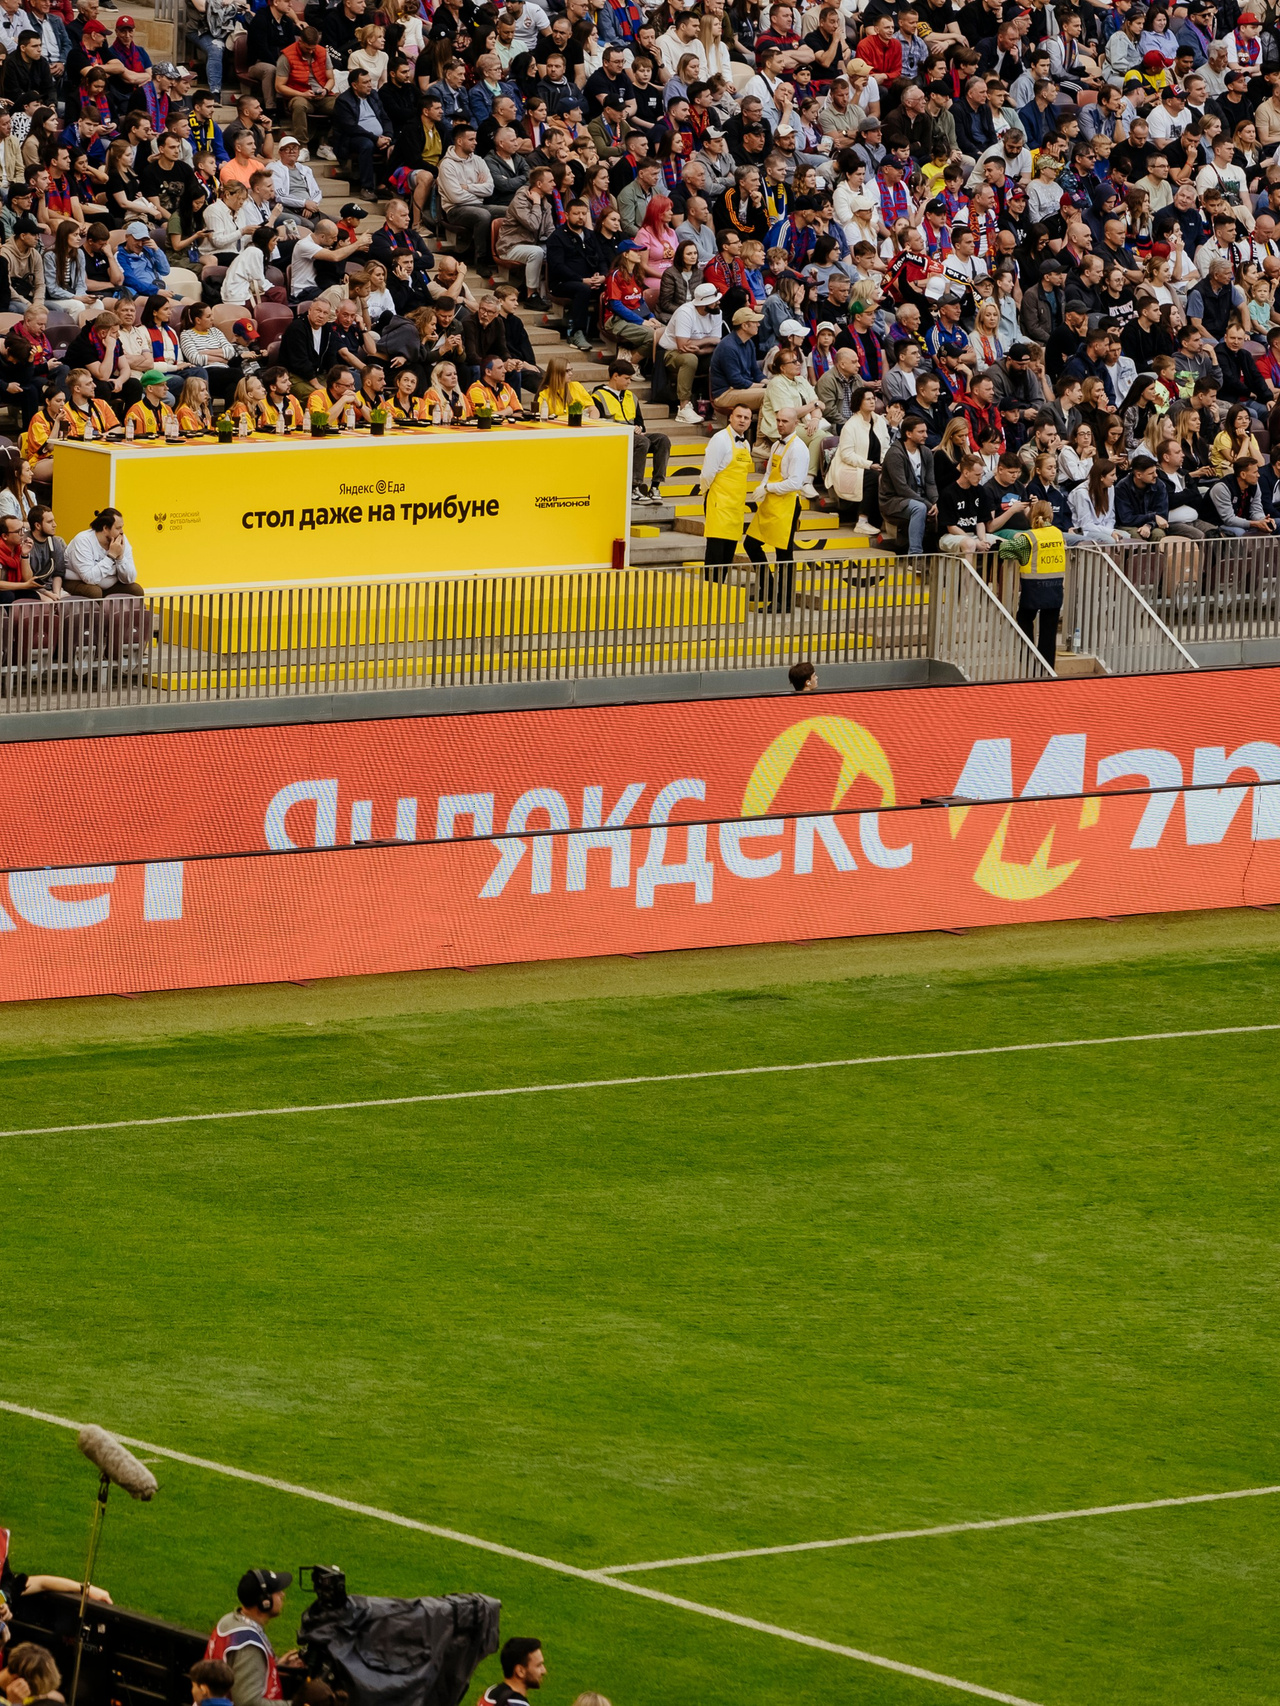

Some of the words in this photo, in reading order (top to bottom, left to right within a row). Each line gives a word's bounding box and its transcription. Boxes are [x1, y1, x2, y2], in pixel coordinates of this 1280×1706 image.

[339, 483, 374, 496] Яндекс
[388, 481, 406, 493] Еда
[535, 501, 590, 509] ЧЕМПИОНОВ
[242, 509, 295, 529] стол
[299, 504, 363, 530] даже
[368, 504, 395, 522] на
[401, 495, 499, 525] трибуне
[169, 517, 201, 525] ФУТБОЛЬНЫЙ
[1040, 541, 1062, 549] SAFETY
[1040, 556, 1064, 565] K0763
